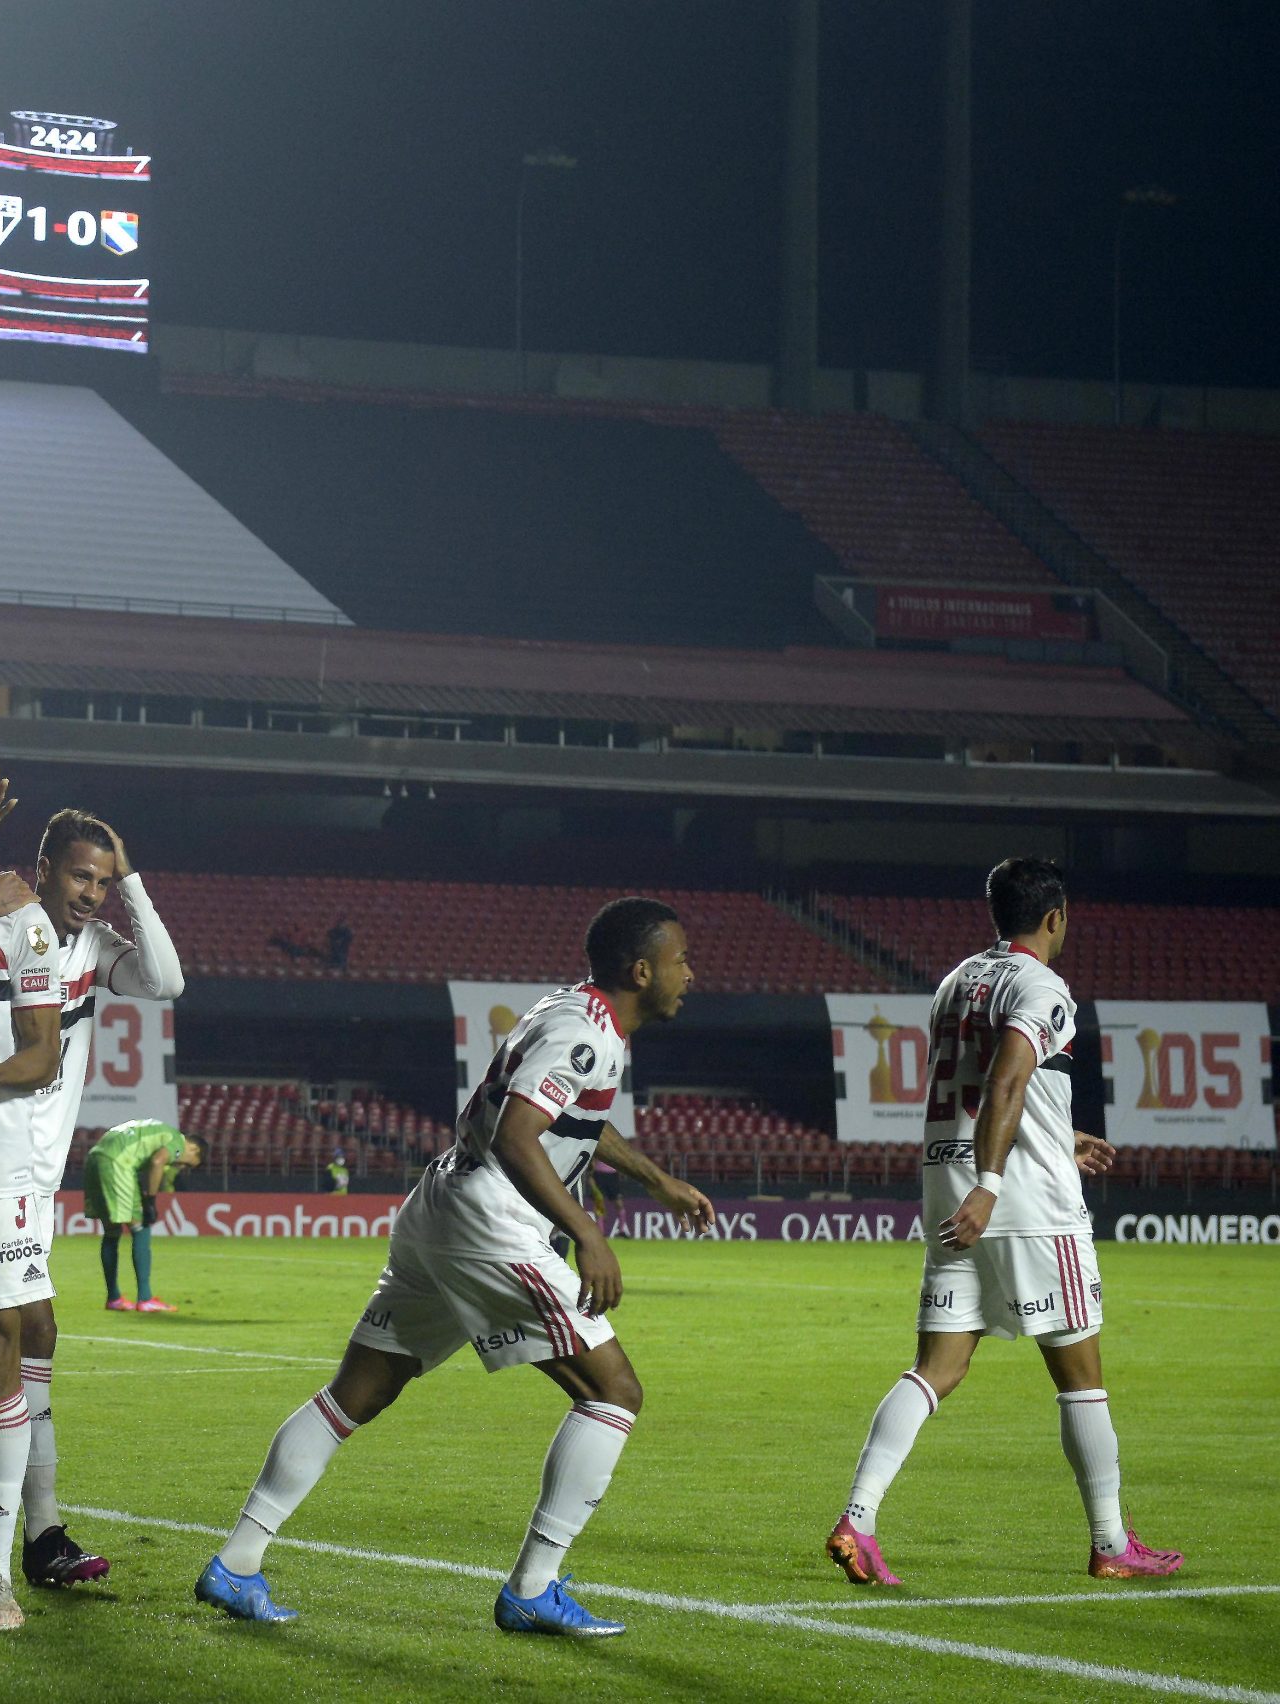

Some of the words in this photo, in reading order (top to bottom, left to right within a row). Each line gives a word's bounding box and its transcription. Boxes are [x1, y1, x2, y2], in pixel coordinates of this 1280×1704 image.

[30, 126, 98, 153] 24:24
[20, 966, 51, 975] CIMENTO
[548, 1070, 572, 1094] CIMENTO
[1156, 1032, 1243, 1110] 05
[14, 1195, 27, 1230] 3
[781, 1212, 895, 1243] QATAR
[1115, 1213, 1280, 1245] CONMEBO
[22, 1272, 46, 1283] adidas
